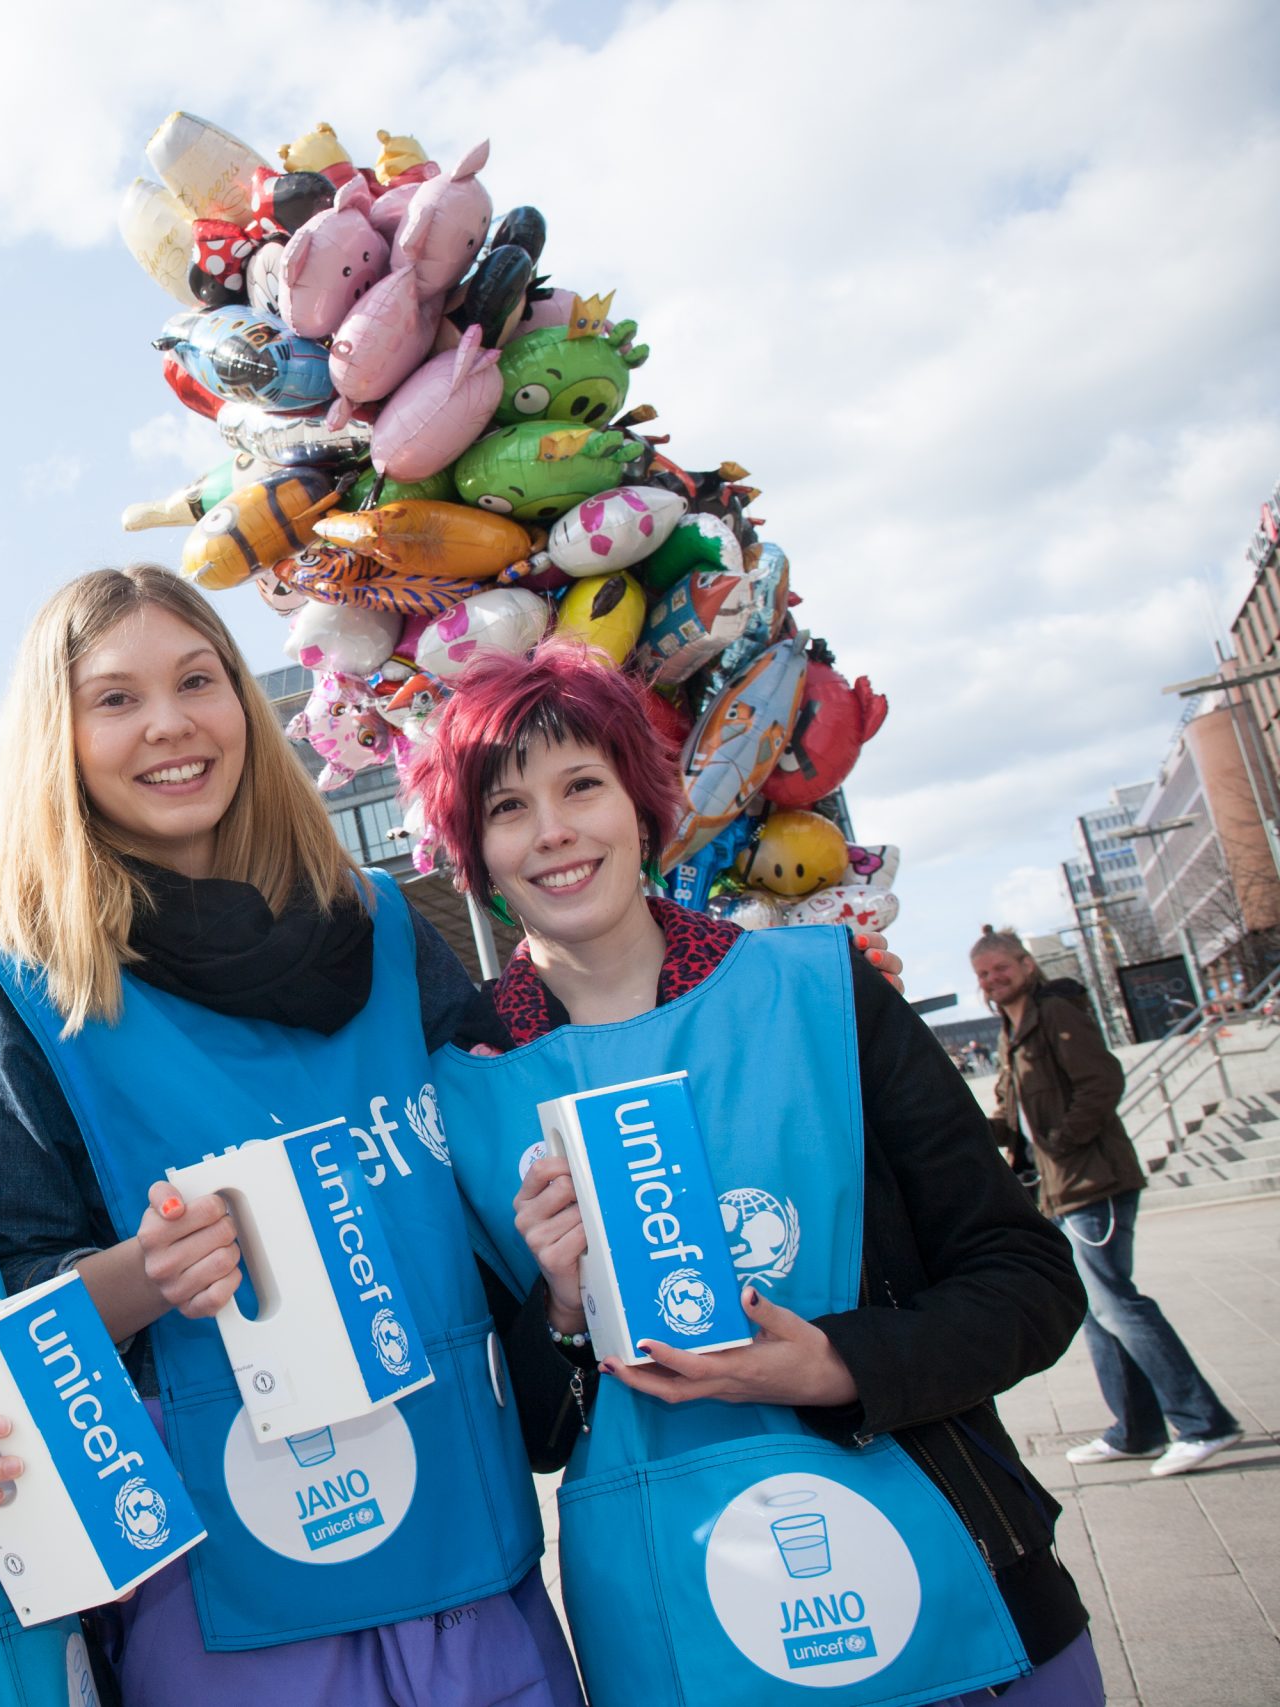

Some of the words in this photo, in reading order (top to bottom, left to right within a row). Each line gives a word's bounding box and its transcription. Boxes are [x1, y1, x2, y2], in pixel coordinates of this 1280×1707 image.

[614, 1098, 704, 1263] unicef
[310, 1141, 393, 1303] unicef
[28, 1308, 145, 1480] unicef
[295, 1469, 370, 1520] JANO
[311, 1512, 356, 1542] unicef
[780, 1590, 865, 1634] JANO
[792, 1636, 845, 1661] unicef
